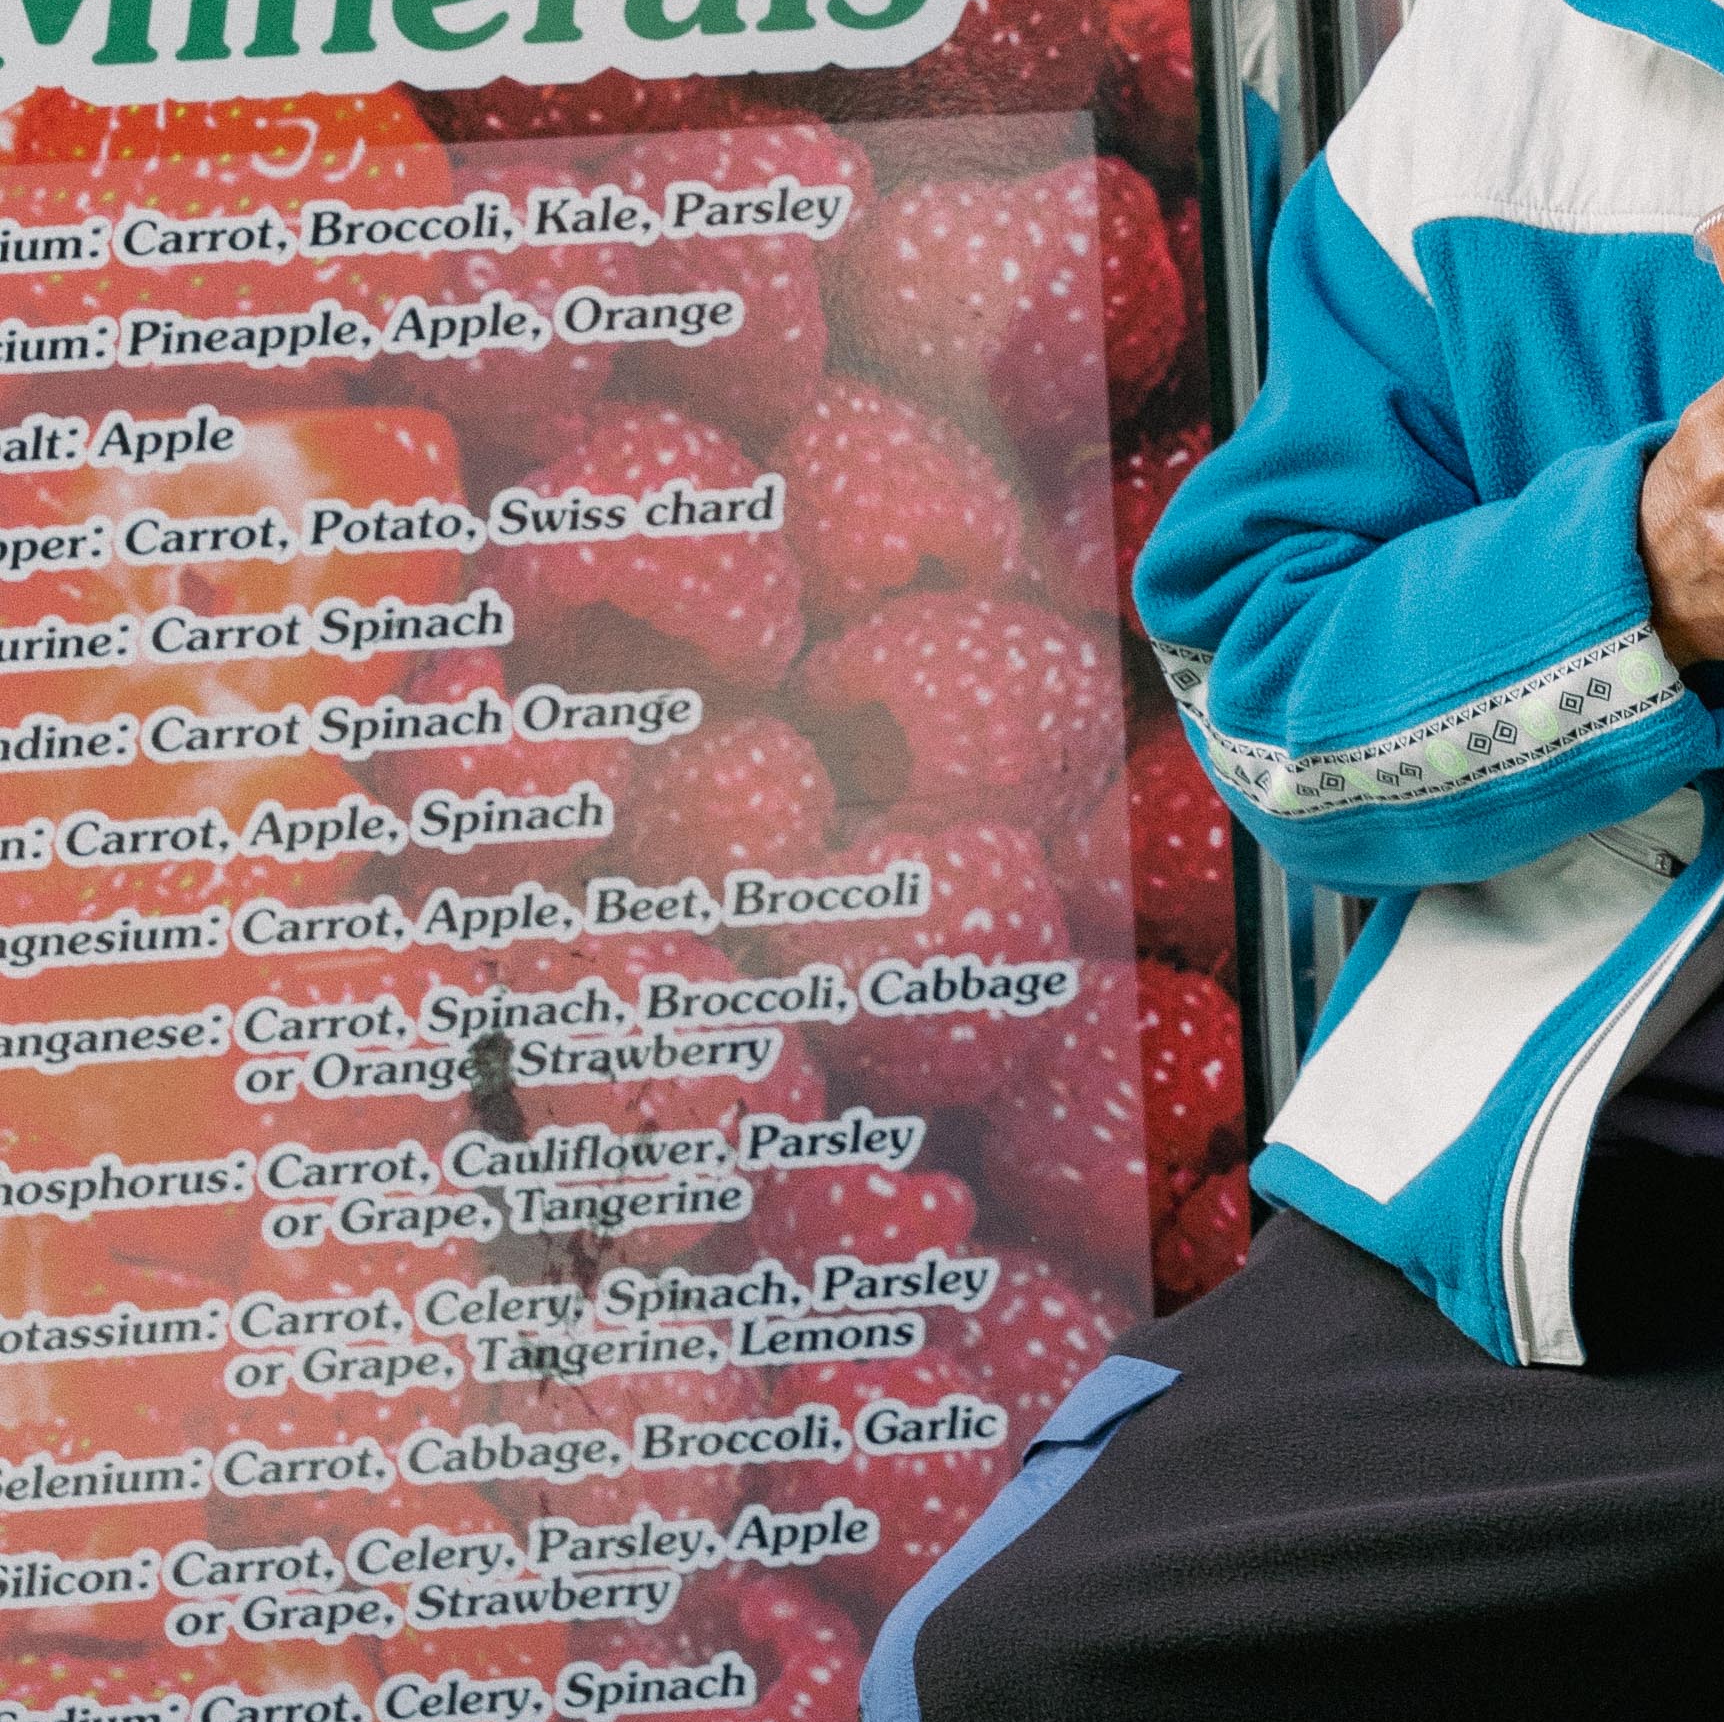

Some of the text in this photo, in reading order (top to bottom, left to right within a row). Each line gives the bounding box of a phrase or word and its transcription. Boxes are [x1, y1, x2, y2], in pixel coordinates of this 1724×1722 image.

[123, 219, 287, 256] Carrot,
[310, 203, 512, 247] Broccoli,
[536, 196, 651, 235] Kale,
[674, 186, 843, 230] Parsley
[129, 310, 371, 358] Pineapple,
[393, 302, 541, 349] Apple,
[565, 297, 733, 339] Orange
[99, 416, 234, 464] Apple
[125, 518, 288, 555] Carrot,
[311, 510, 477, 545] Potato,
[498, 498, 625, 534] Swiss
[646, 486, 774, 527] chard
[152, 617, 299, 653] Carrot
[320, 600, 503, 650] Spinach
[151, 716, 298, 753] Carrot
[320, 699, 502, 750] Spinach
[523, 696, 690, 733] Orange
[66, 820, 228, 857] Carrot,
[251, 806, 398, 852] Apple,
[420, 793, 602, 843] Spinach
[242, 908, 404, 944] Carrot,
[425, 893, 572, 940] Apple,
[596, 889, 710, 924] Beet,
[734, 872, 919, 916] Broccoli
[244, 1006, 406, 1043] Carrot,
[648, 975, 847, 1013] Broccoli,
[870, 965, 1070, 1007] Cabbage
[246, 1069, 294, 1093] or
[268, 1152, 429, 1189] Carrot,
[748, 1117, 917, 1161] Parsley
[273, 1214, 321, 1238] or
[341, 1197, 492, 1237] Grape,
[241, 1302, 402, 1337] Carrot,
[822, 1261, 991, 1304] Parsley
[235, 1363, 284, 1388] or
[303, 1348, 453, 1386] Grape,
[739, 1319, 916, 1357] Lemons
[224, 1450, 384, 1486] Carrot,
[409, 1434, 620, 1474] Cabbage,
[643, 1413, 843, 1460] Broccoli,
[864, 1404, 997, 1446] Garlic
[172, 1549, 336, 1587] Carrot,
[355, 1537, 517, 1574] Celery,
[537, 1523, 718, 1565] Parsley,
[733, 1508, 870, 1555] Apple
[175, 1575, 671, 1637] or Grape, Strawberry
[385, 1680, 543, 1721] Celery,
[564, 1663, 748, 1715] Spinach
